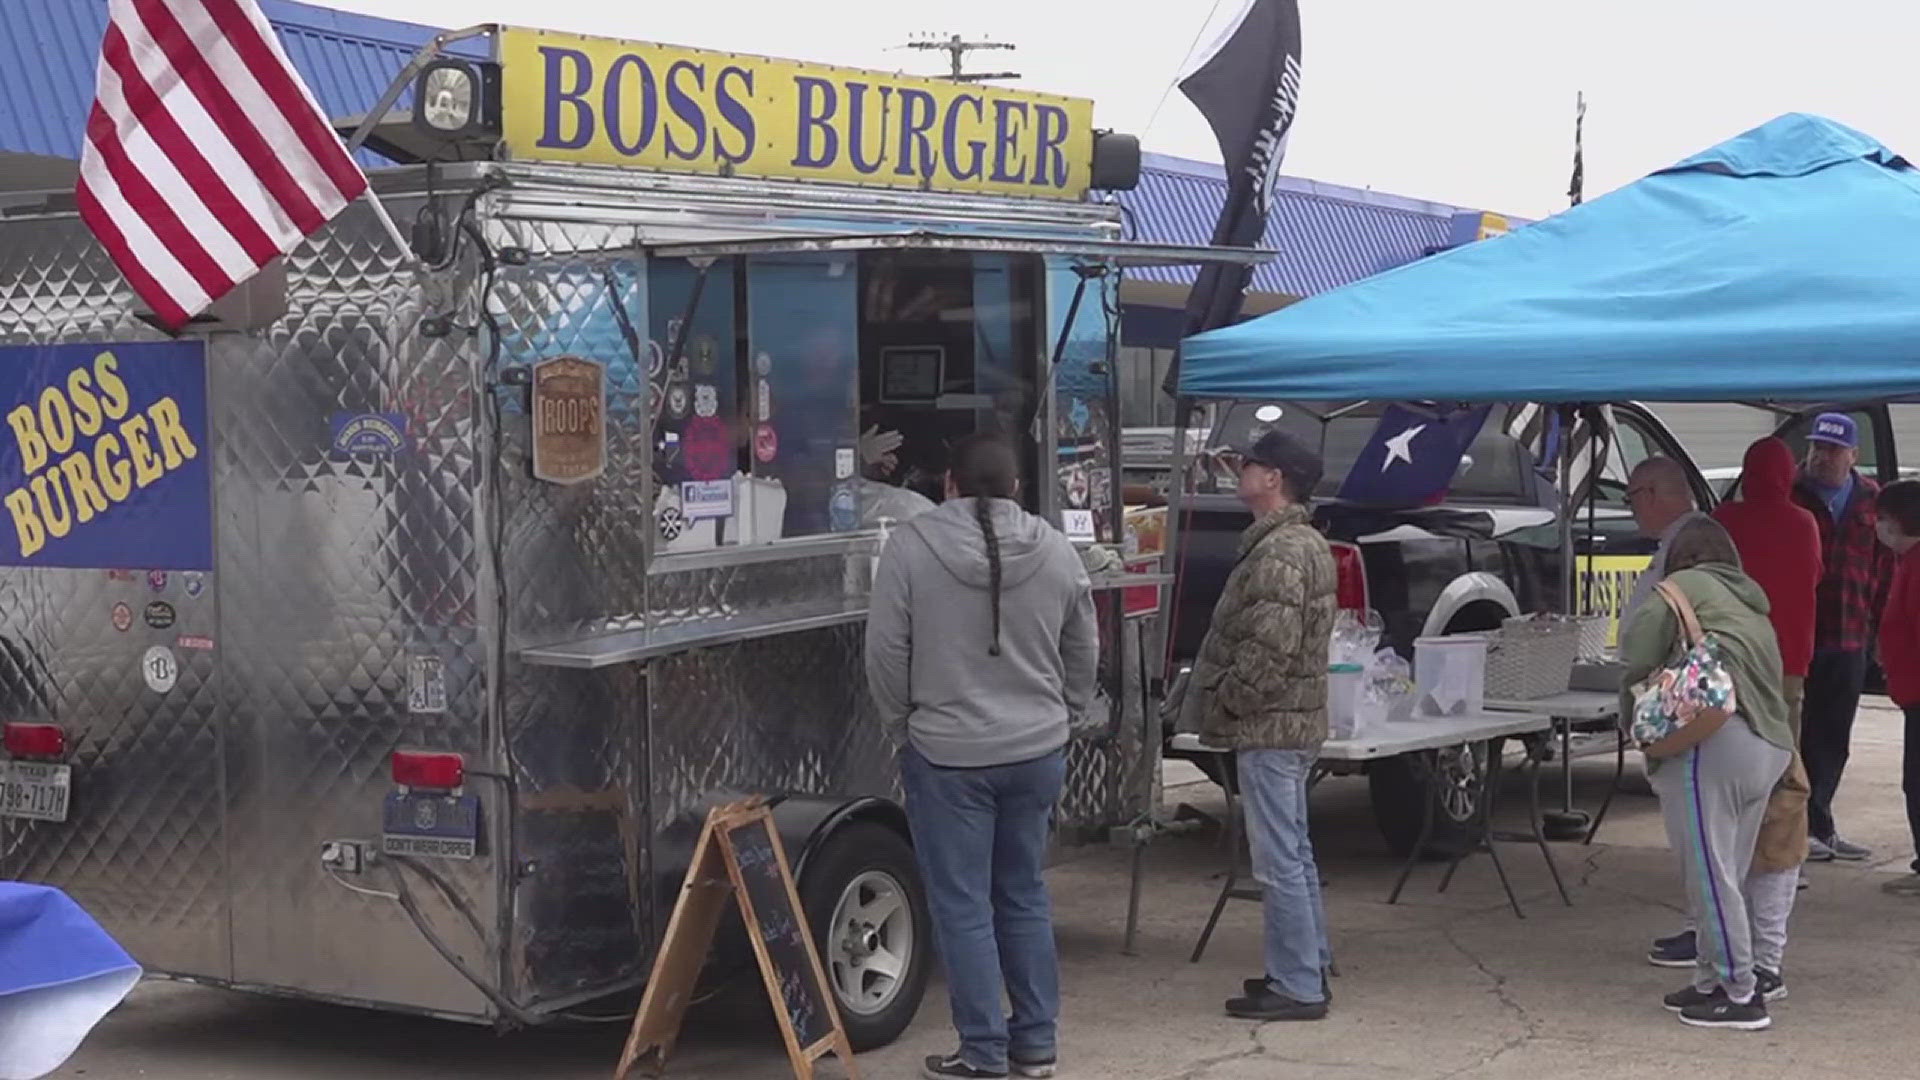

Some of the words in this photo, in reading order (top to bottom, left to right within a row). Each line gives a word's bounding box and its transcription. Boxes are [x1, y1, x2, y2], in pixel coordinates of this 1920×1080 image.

[535, 46, 756, 165] BOSS
[790, 75, 1070, 189] BURGER
[4, 396, 198, 558] BURGER
[6, 351, 129, 475] BOSS
[538, 395, 599, 435] TROOPS
